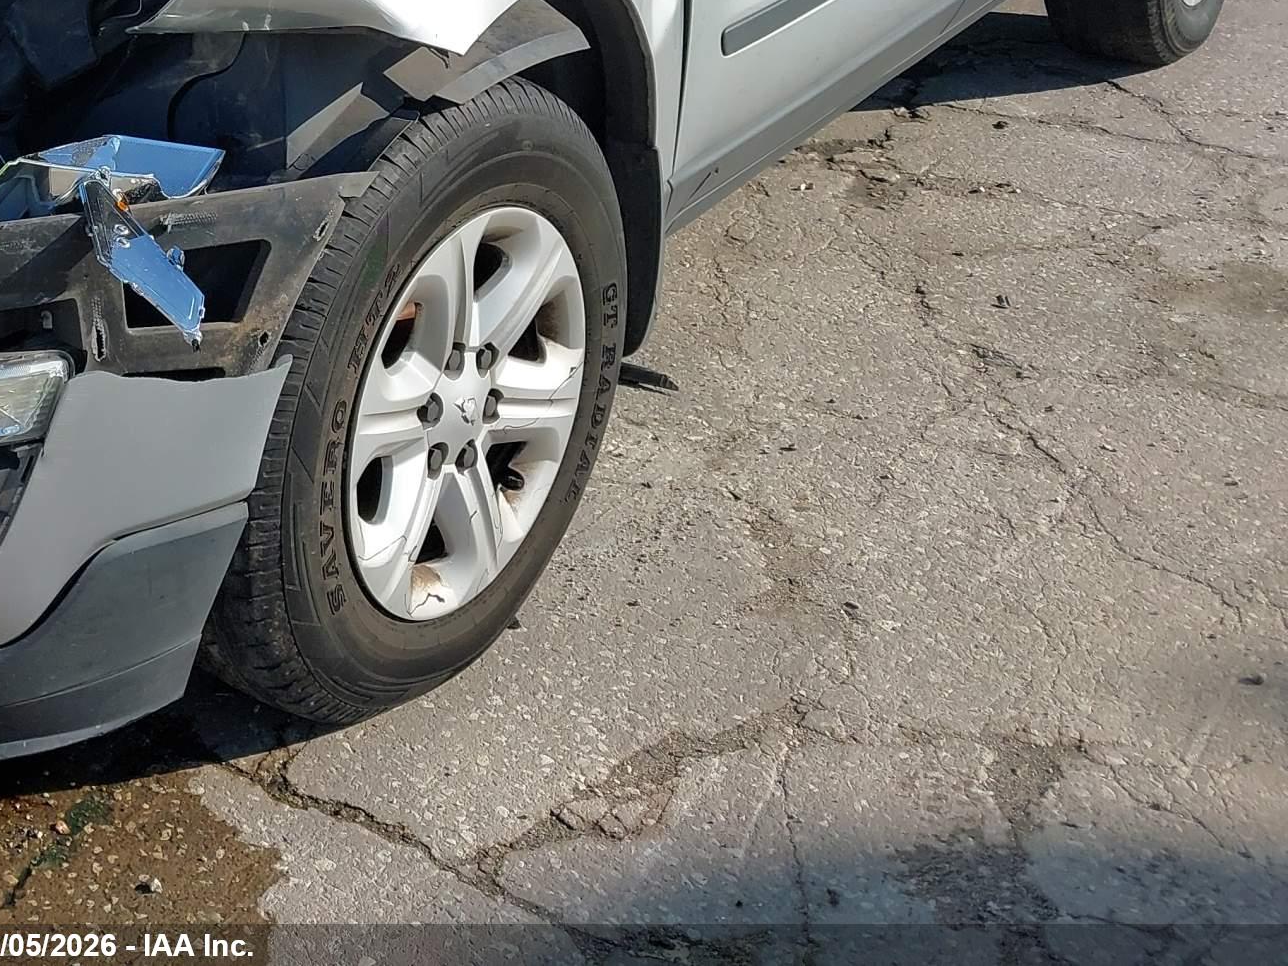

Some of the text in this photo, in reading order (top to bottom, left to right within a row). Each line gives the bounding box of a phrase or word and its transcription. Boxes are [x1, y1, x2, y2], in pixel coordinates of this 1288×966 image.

[565, 282, 618, 502] GT RADIAL
[319, 398, 348, 616] SAVERO
